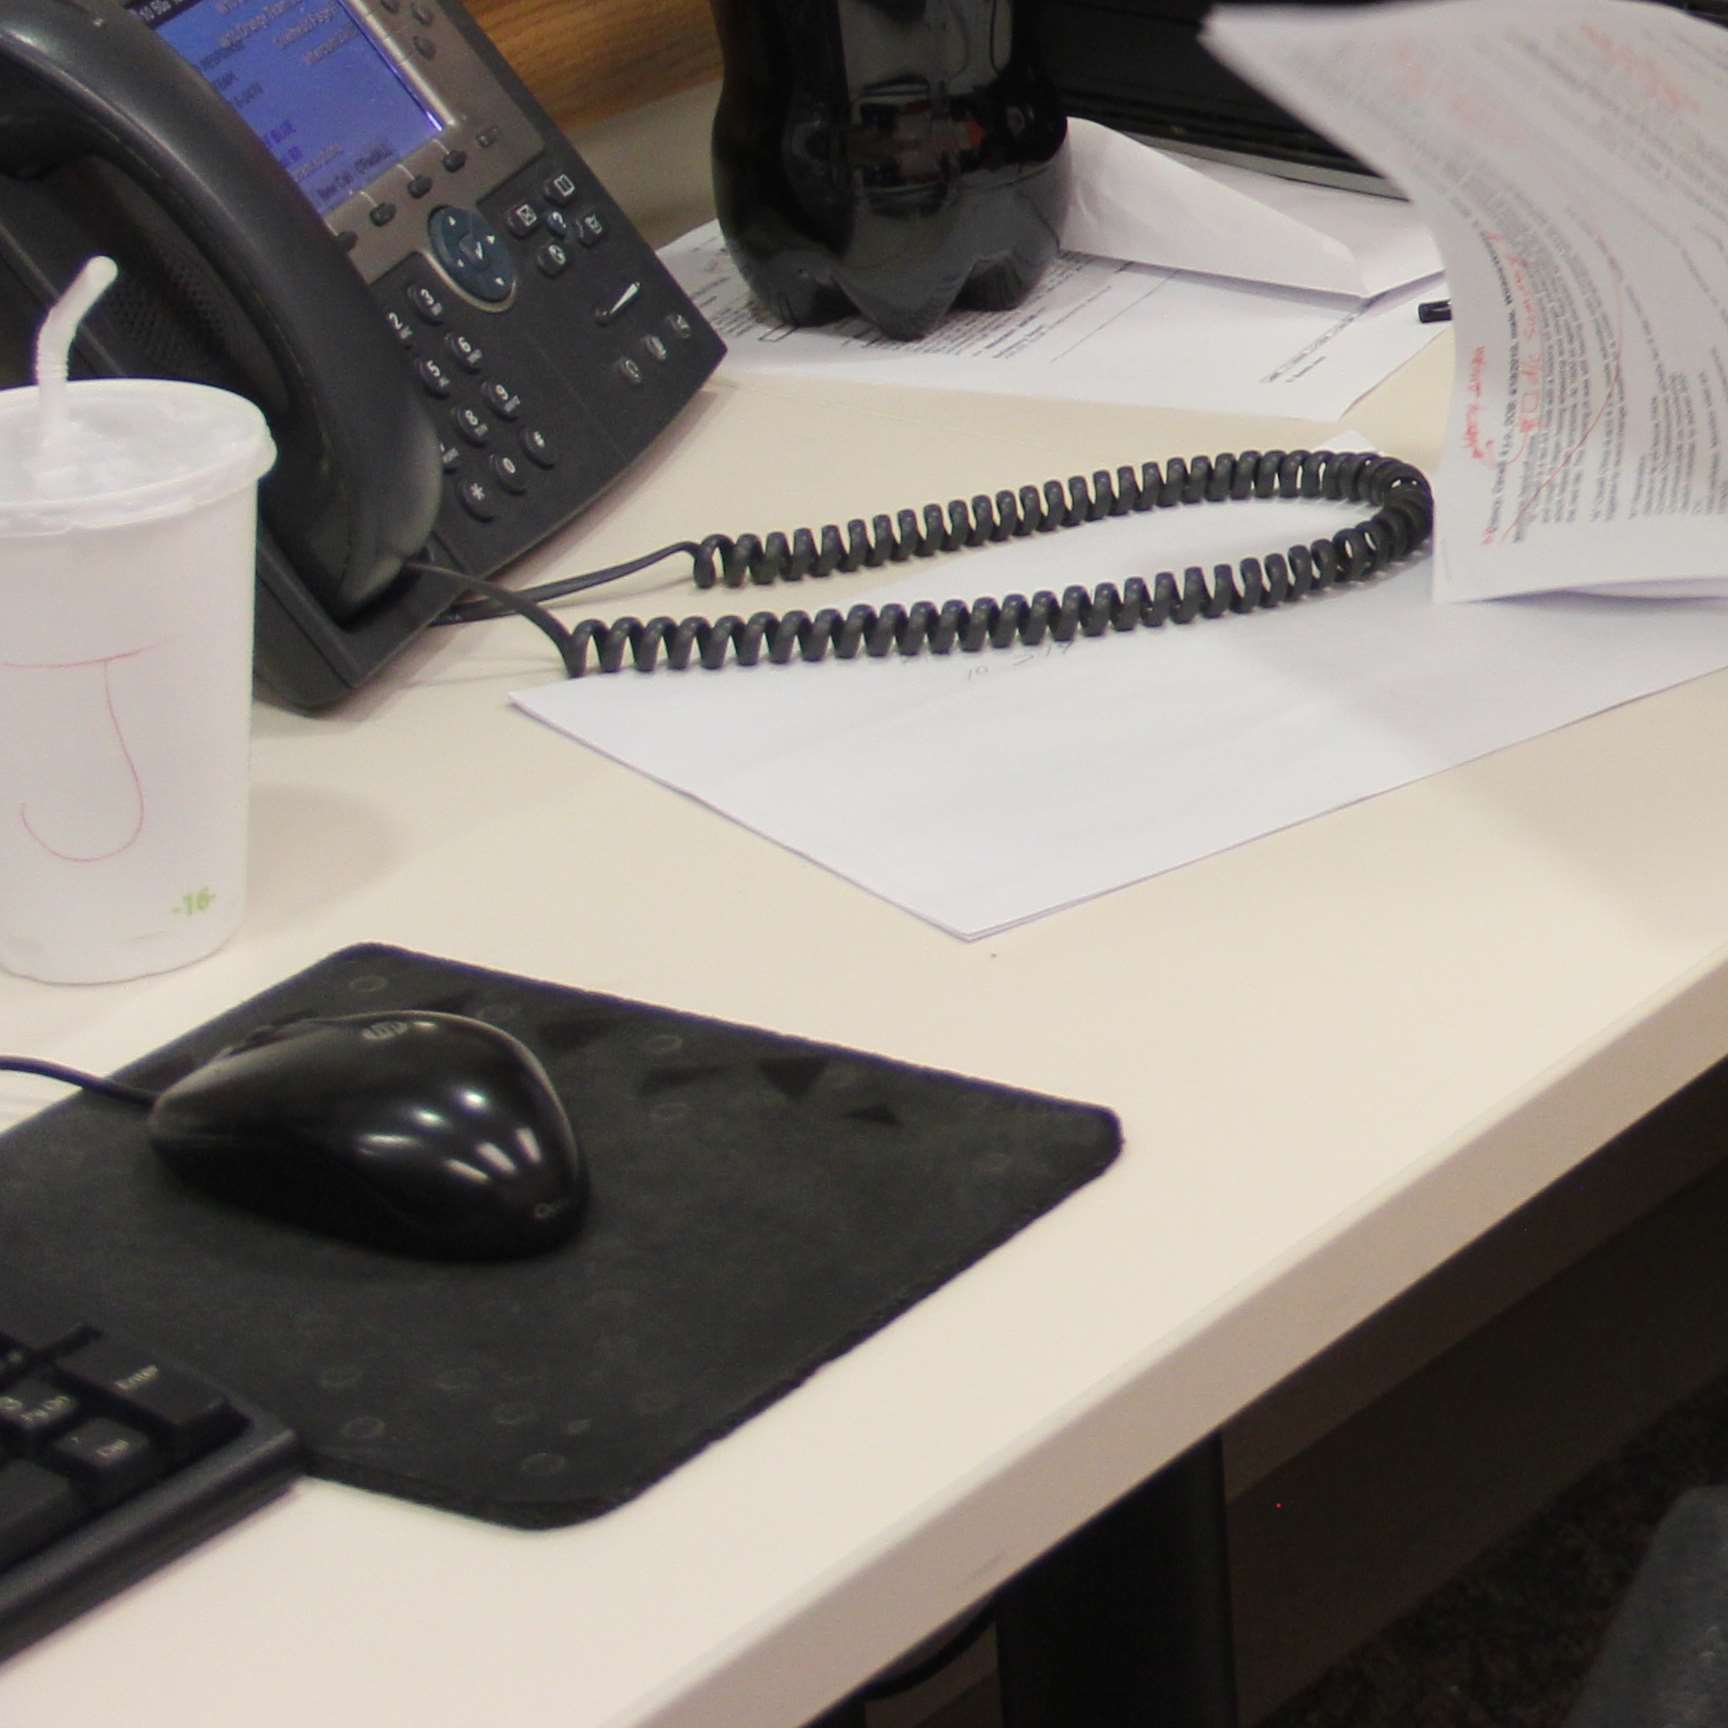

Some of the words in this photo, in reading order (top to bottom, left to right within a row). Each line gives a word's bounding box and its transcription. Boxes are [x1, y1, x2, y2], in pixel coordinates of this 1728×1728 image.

[419, 287, 434, 306] 3
[387, 311, 403, 330] 2
[457, 335, 471, 352] 6
[427, 359, 442, 377] 5
[494, 384, 509, 402] 9
[465, 409, 479, 427] 8
